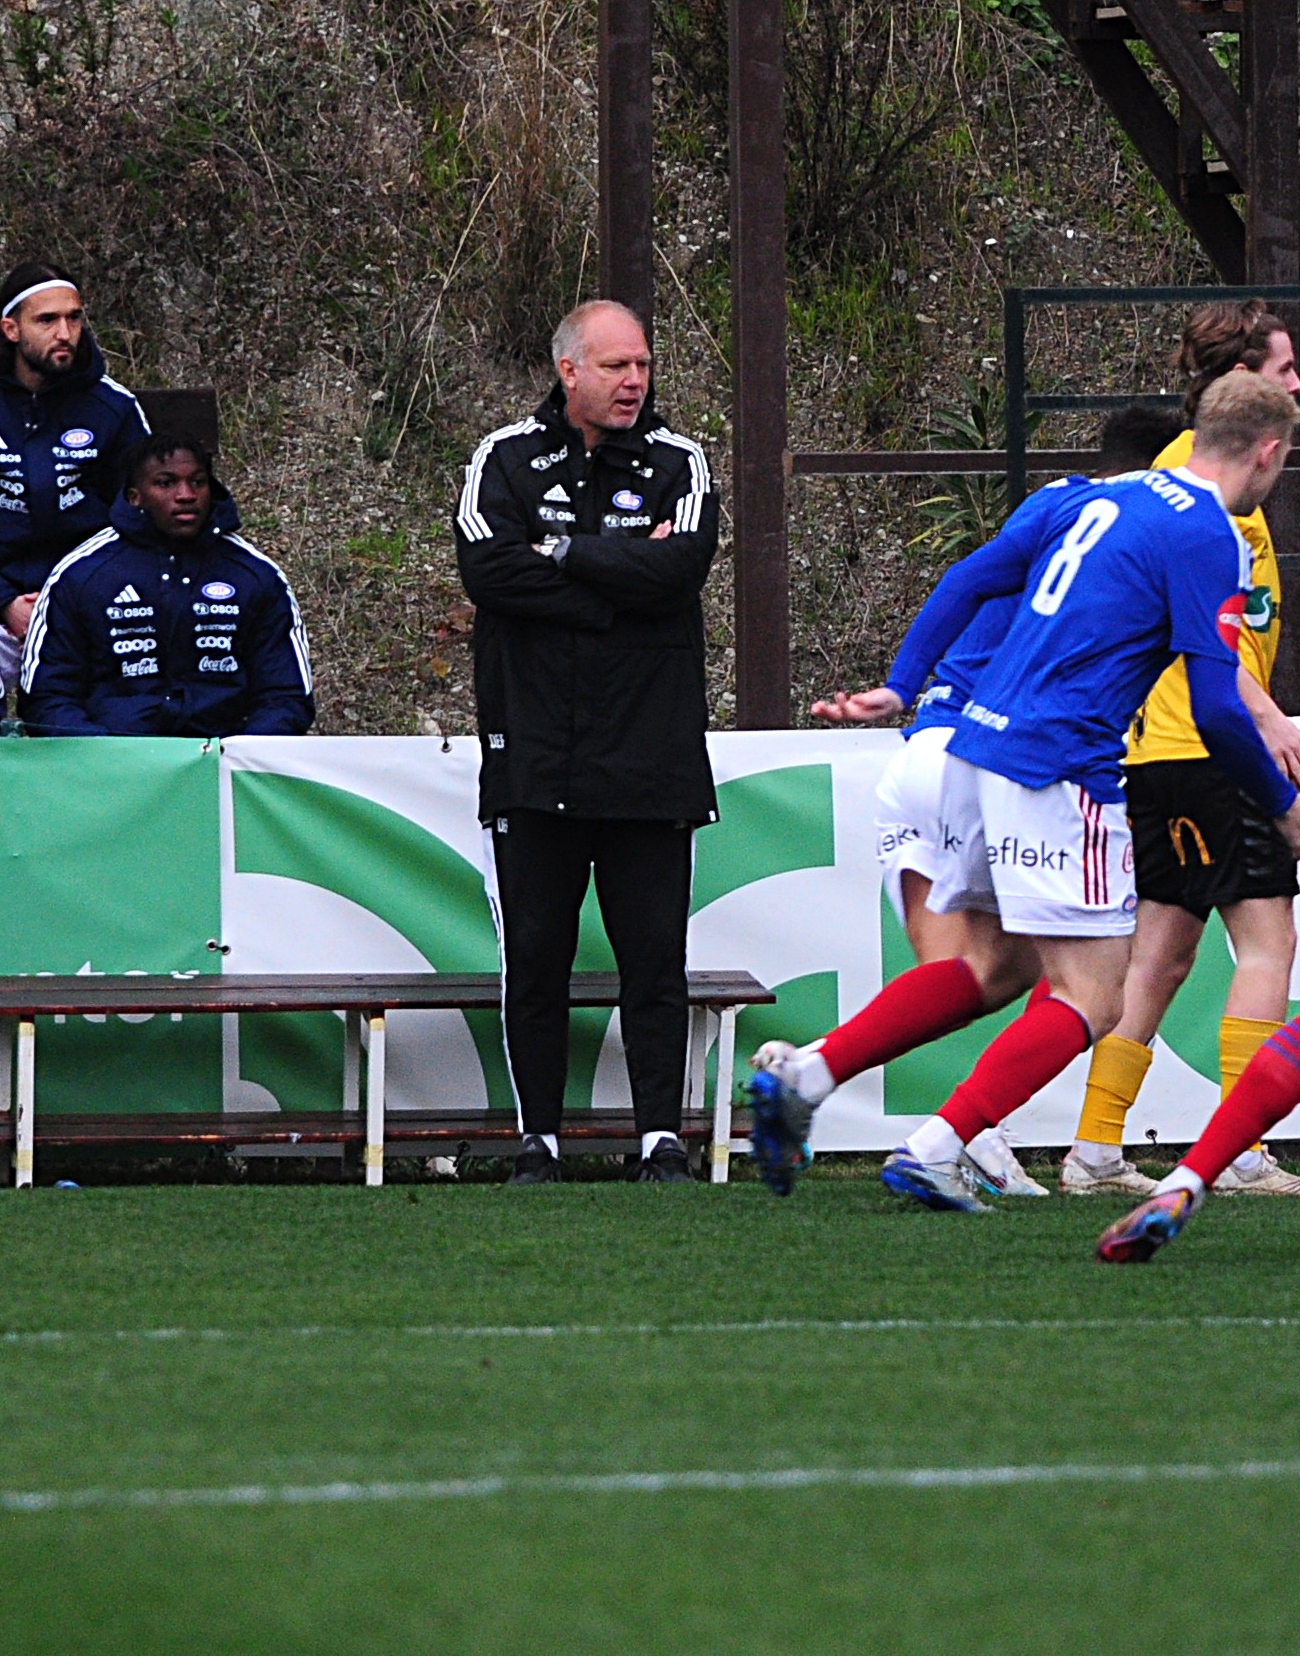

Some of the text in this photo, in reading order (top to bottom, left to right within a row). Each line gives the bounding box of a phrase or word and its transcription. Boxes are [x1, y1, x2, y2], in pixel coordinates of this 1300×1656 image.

[621, 516, 651, 527] OBOS
[1031, 498, 1120, 616] 8
[124, 606, 154, 618] OBOS
[210, 604, 239, 615] OBOS
[113, 638, 157, 653] coop
